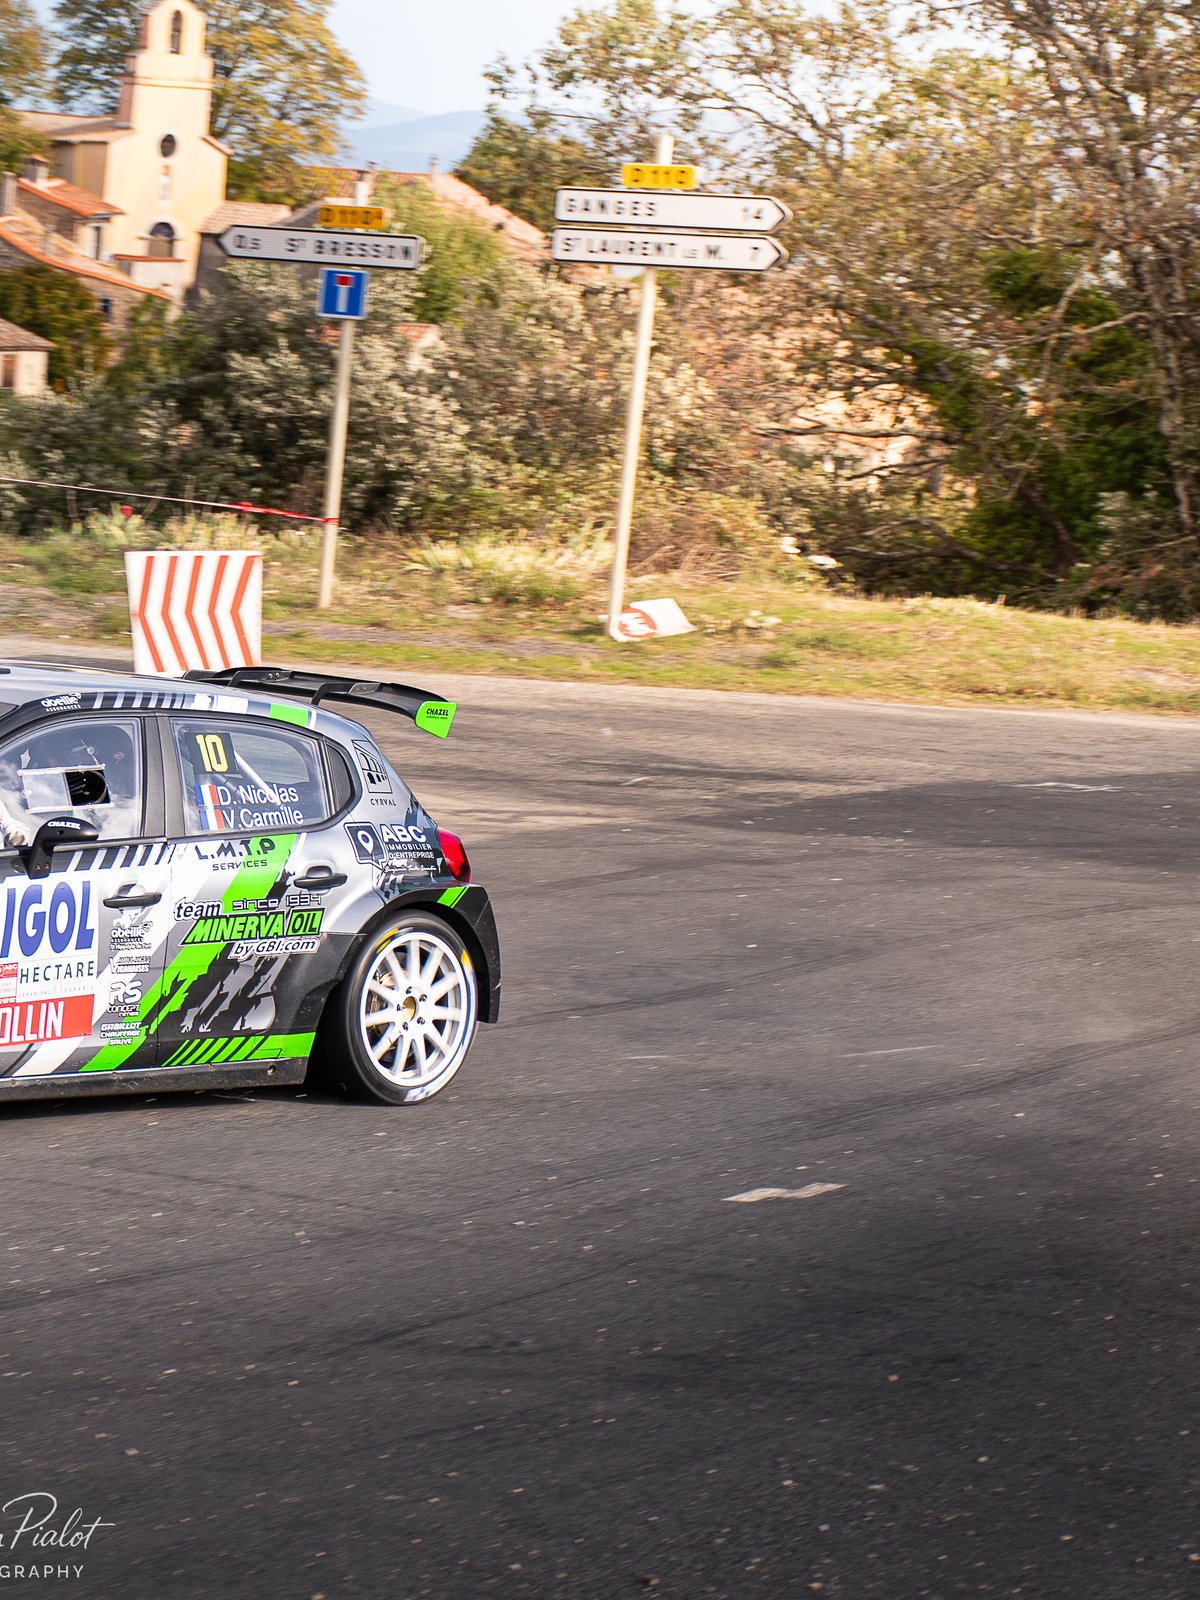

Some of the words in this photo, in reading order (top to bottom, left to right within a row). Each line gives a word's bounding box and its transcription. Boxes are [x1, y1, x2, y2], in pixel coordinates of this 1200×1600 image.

[629, 168, 644, 184] D
[319, 207, 335, 223] D
[564, 197, 658, 218] GANGES
[741, 206, 765, 221] 14
[314, 238, 413, 260] BRESSON
[586, 238, 678, 258] LAURENT
[750, 245, 762, 262] 7
[426, 708, 449, 716] CHAZEL
[195, 734, 229, 773] 10
[216, 786, 237, 806] D.
[239, 783, 299, 806] Nicolas
[369, 797, 397, 808] CYRVAL
[380, 824, 427, 843] ABC
[385, 843, 433, 851] IMMOBILIER
[388, 851, 435, 860] D'ENTREPRISE
[212, 859, 268, 871] SERVICES
[176, 901, 221, 919] team
[232, 898, 279, 911] since
[285, 893, 322, 907] 1934
[0, 880, 95, 959] IGOL
[184, 911, 285, 943] MINERVA
[291, 912, 318, 934] OIL
[234, 943, 254, 957] by
[19, 960, 95, 985] HECTARE
[109, 979, 143, 1006] RS
